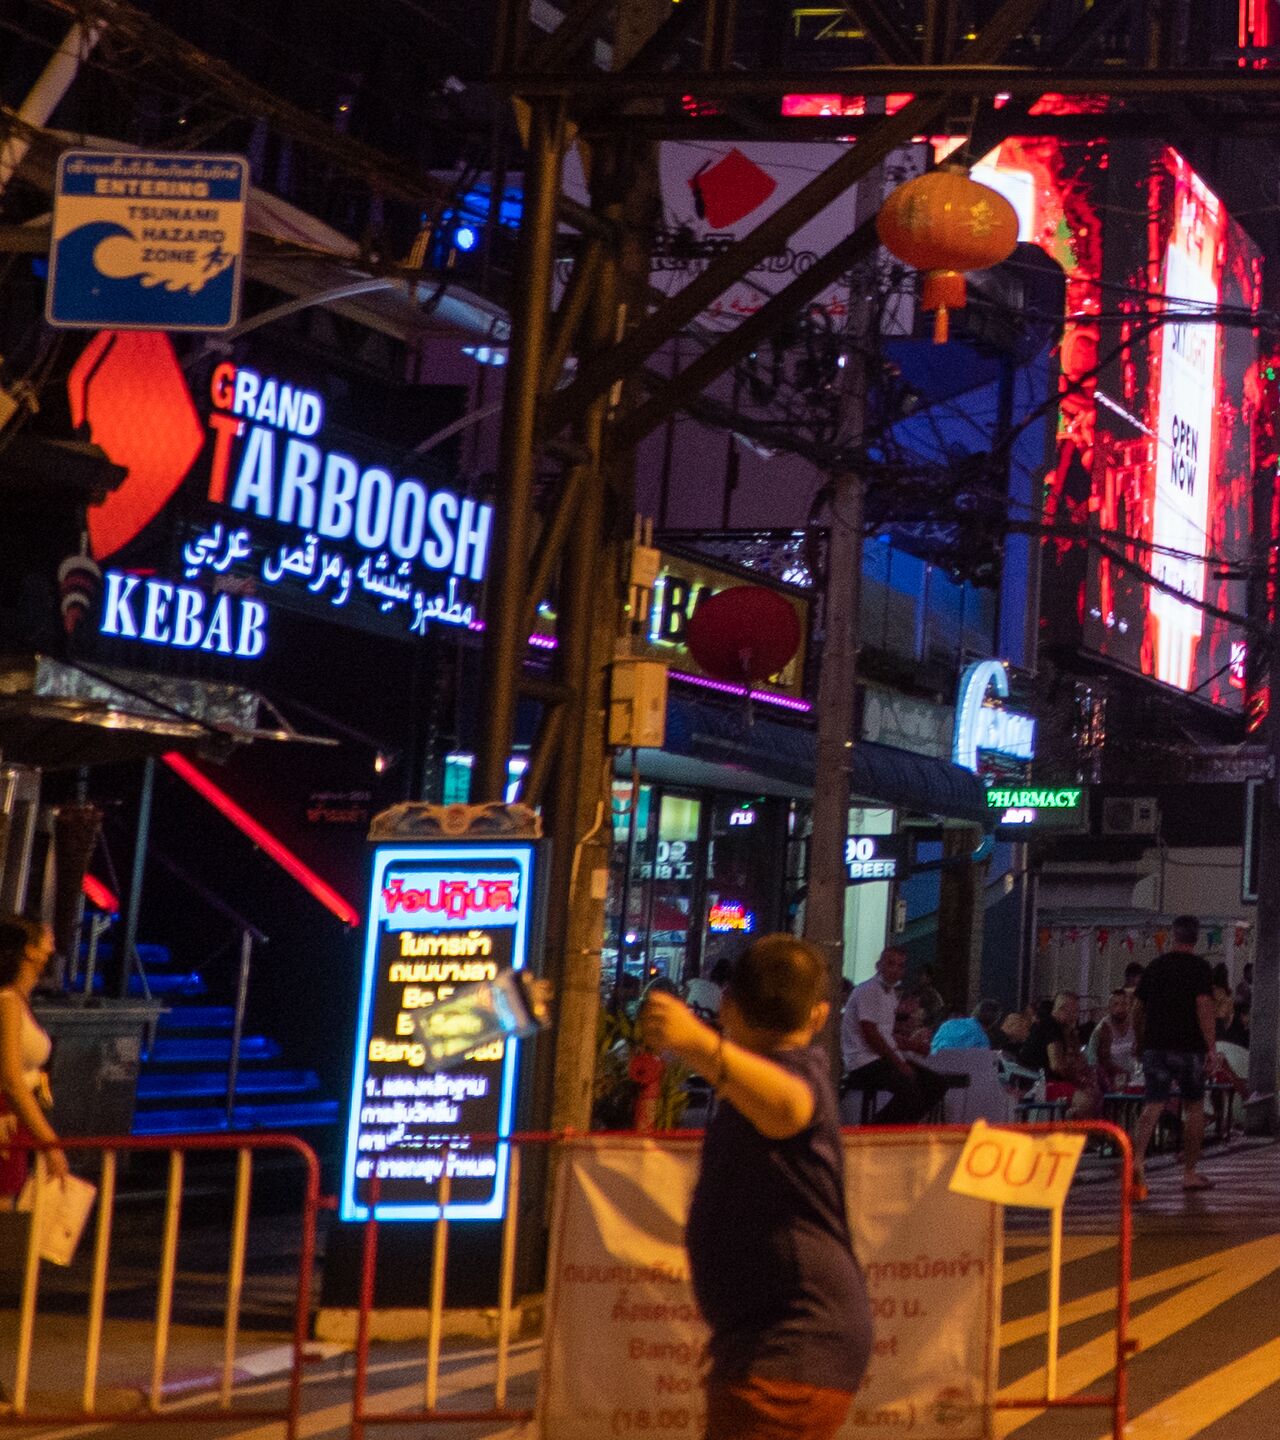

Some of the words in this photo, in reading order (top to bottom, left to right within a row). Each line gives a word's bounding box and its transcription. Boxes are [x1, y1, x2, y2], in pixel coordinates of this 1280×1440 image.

[95, 178, 209, 197] ENTERING
[128, 206, 219, 221] TSUNAMI
[142, 228, 225, 243] HAZARD
[142, 249, 196, 263] ZONE
[210, 362, 322, 436] GRAND
[1171, 414, 1199, 463] OPEN
[1170, 452, 1197, 497] NOW
[208, 414, 493, 580] TARBOOSH
[100, 571, 267, 659] KEBAB
[986, 790, 1081, 808] PHARMACY
[850, 861, 896, 879] BEER
[964, 1141, 1075, 1191] OUT
